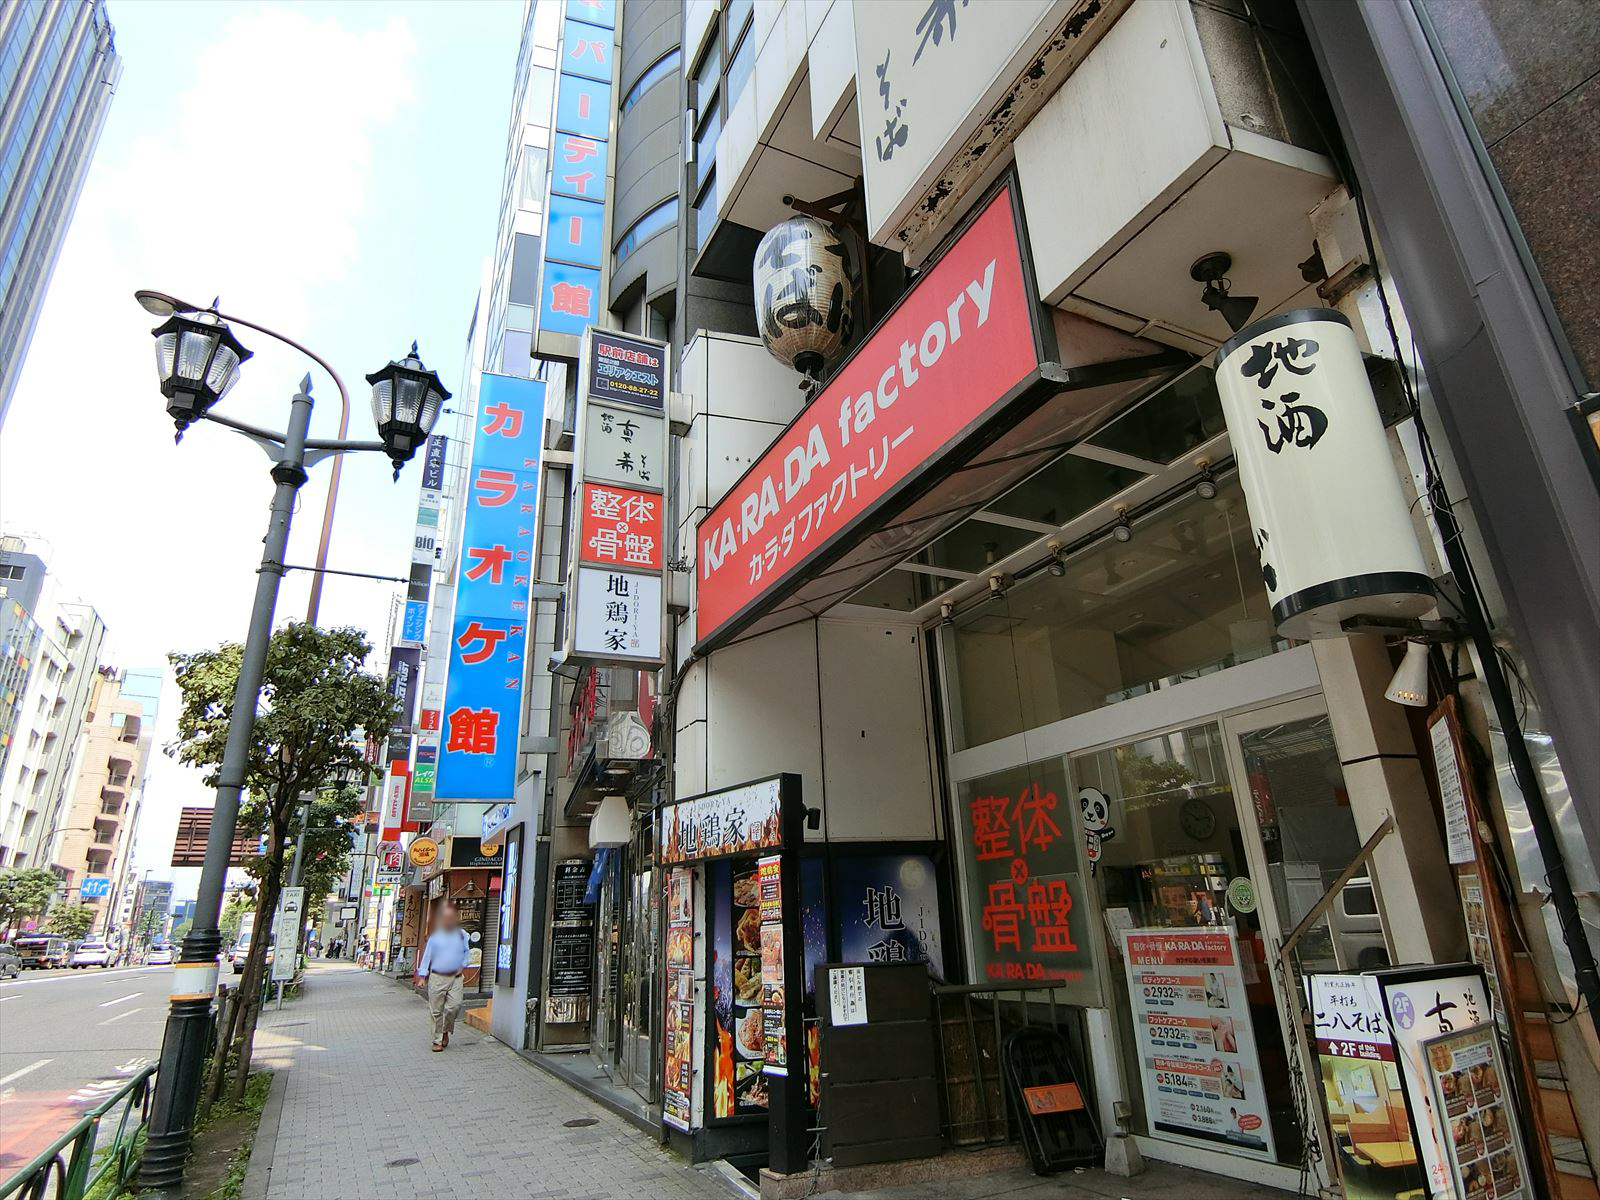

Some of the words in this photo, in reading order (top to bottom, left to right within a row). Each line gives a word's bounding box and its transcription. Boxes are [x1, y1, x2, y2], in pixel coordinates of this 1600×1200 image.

[875, 48, 909, 163] そば
[598, 343, 659, 367] 駅前店舗は
[838, 258, 996, 447] factory
[597, 363, 659, 386] エリアクエスト
[1240, 337, 1328, 455] 地酒
[591, 489, 655, 524] 整体
[589, 527, 654, 565] 骨盤
[446, 401, 524, 755] カラオケ館
[604, 575, 629, 651] 地鶏家
[503, 625, 524, 690] KAN
[679, 807, 747, 855] 地鶏家
[969, 783, 1062, 861] 整体
[982, 879, 1078, 953] 骨盤
[1136, 956, 1164, 965] MENU
[1315, 1012, 1384, 1034] 二八そば
[1330, 995, 1357, 1008] 平打ち
[1394, 997, 1410, 1013] 2F
[1340, 1042, 1356, 1056] 2F
